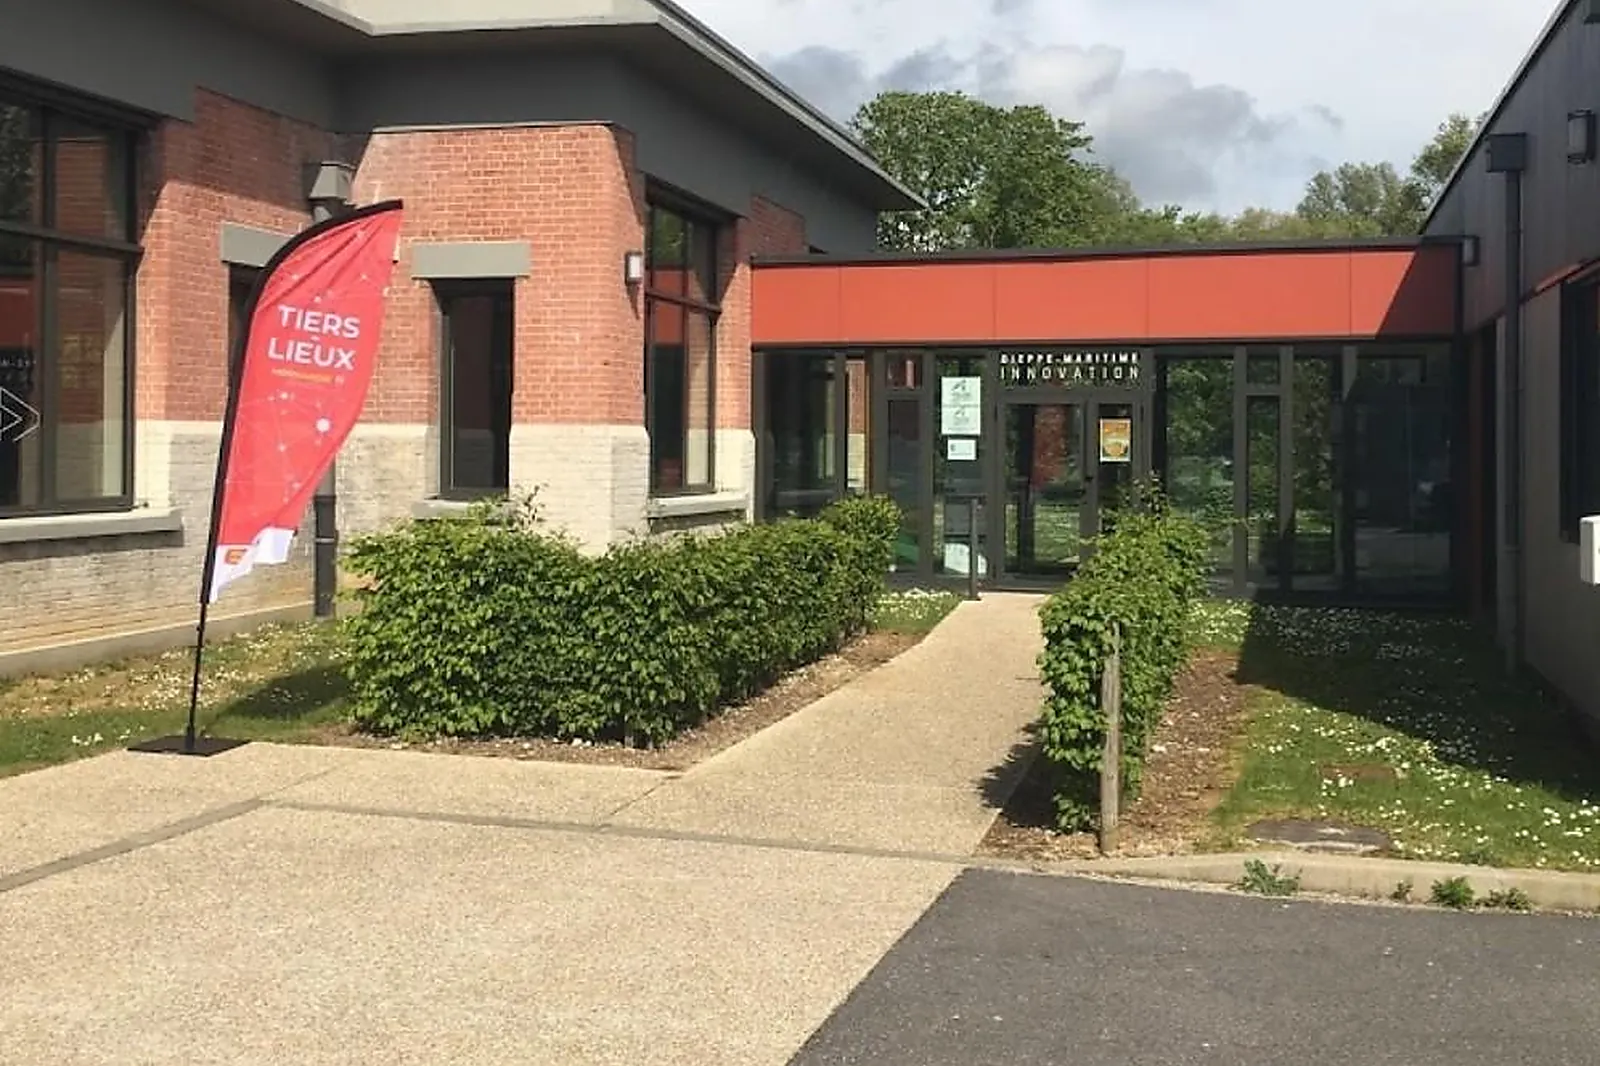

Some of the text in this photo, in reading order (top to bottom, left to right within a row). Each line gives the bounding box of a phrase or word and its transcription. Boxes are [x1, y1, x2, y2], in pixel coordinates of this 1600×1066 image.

[278, 304, 360, 339] TIERS
[268, 337, 356, 371] LIEUX
[1000, 366, 1140, 379] INNOVATION
